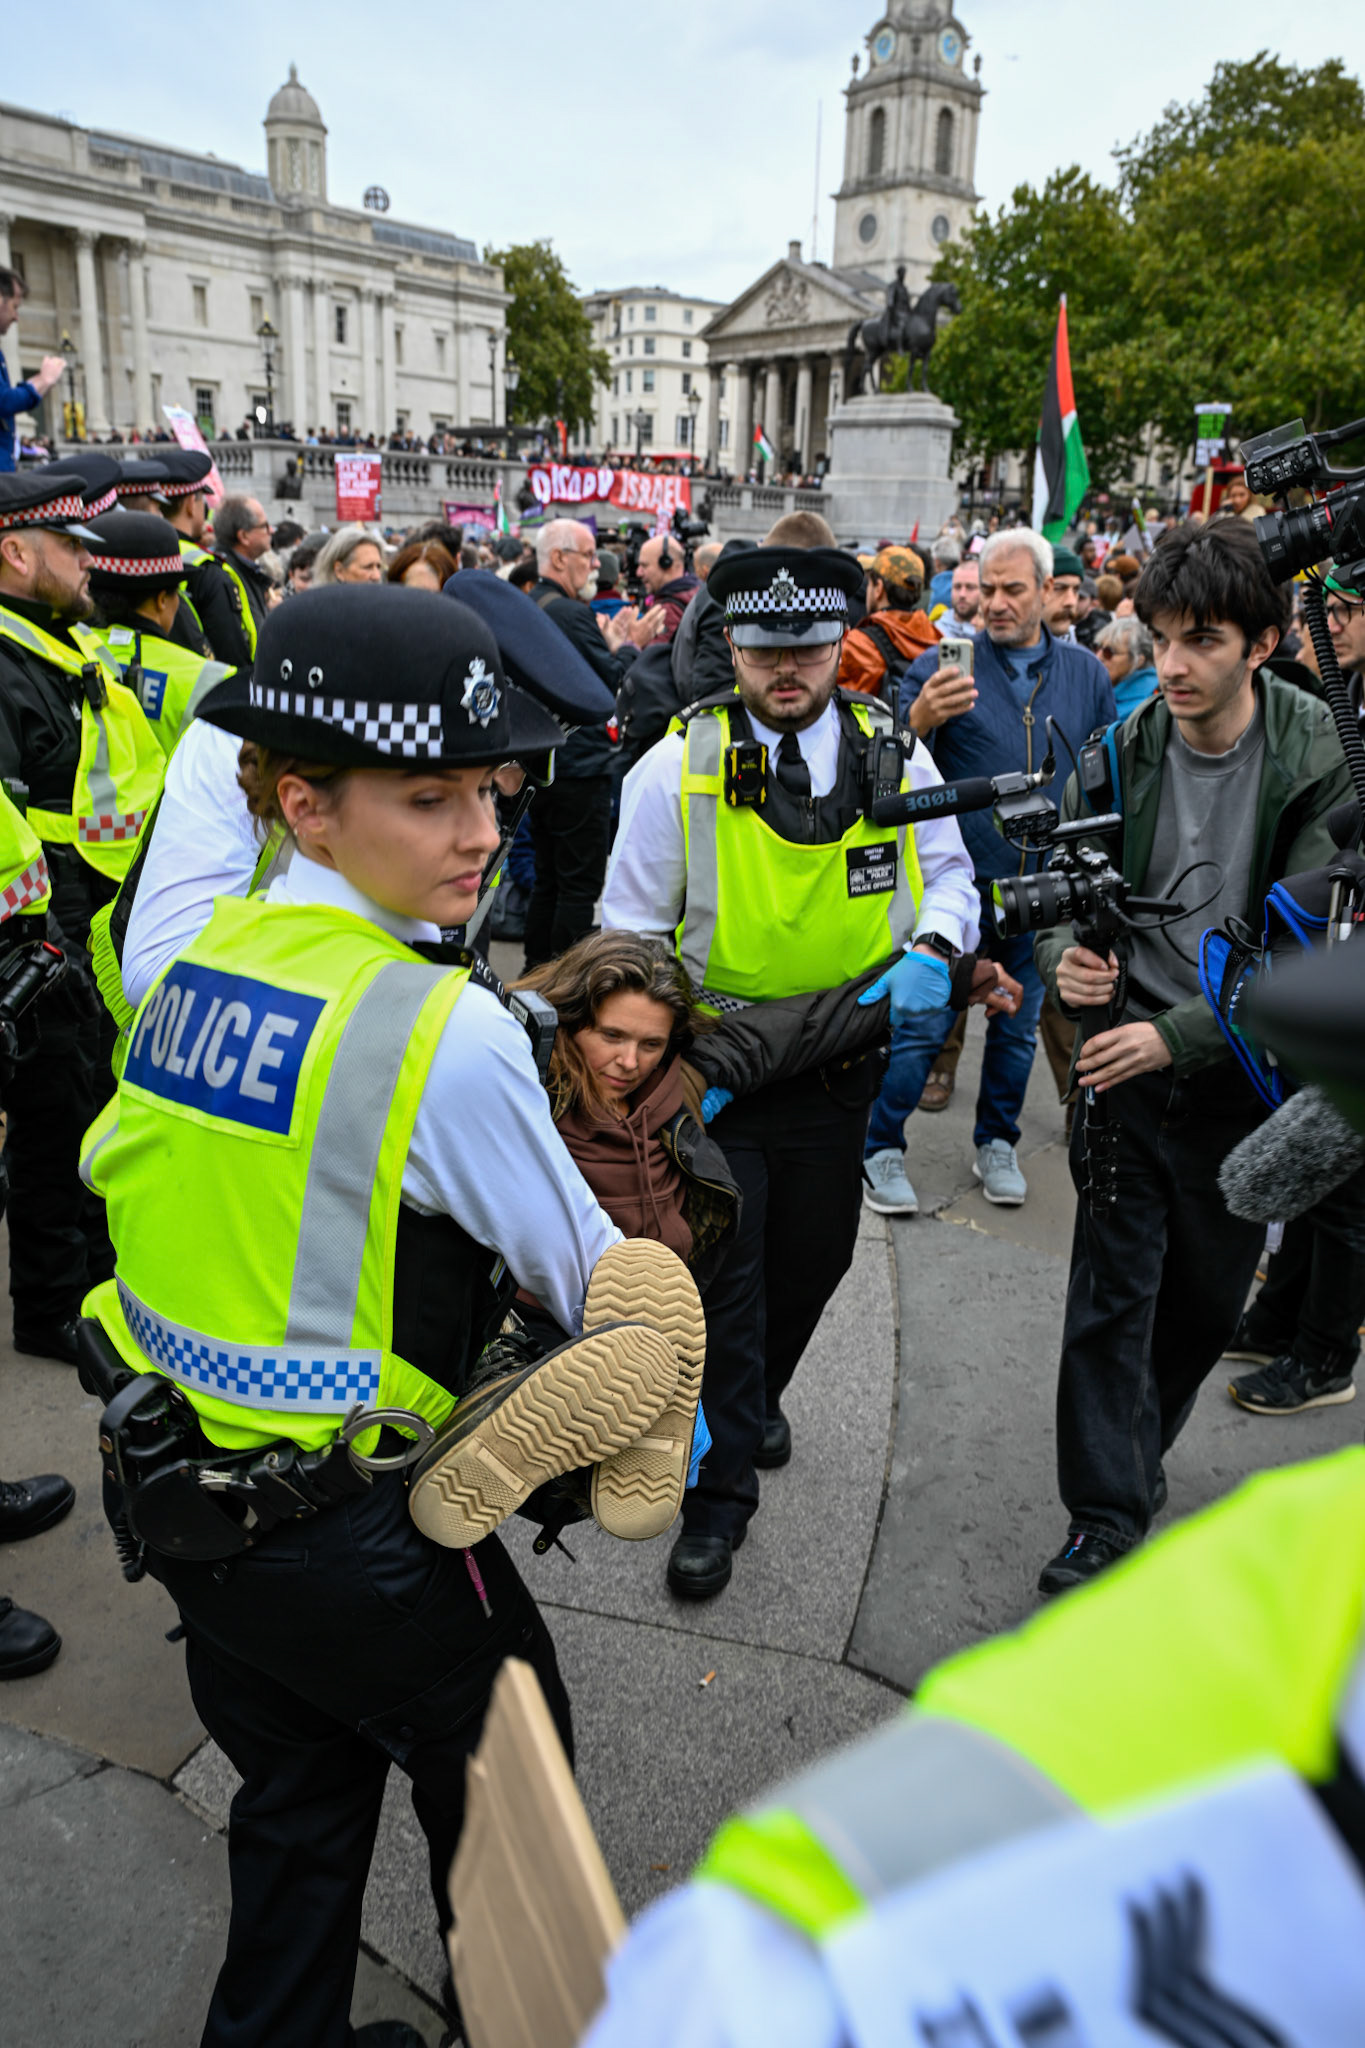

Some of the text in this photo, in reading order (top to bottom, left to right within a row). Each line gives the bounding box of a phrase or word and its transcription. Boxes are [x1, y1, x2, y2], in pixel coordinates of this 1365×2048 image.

[618, 471, 687, 510] ISRAEL
[905, 788, 959, 812] RØDE
[850, 878, 894, 894] POLICE OFFICER
[134, 980, 299, 1104] POLICE
